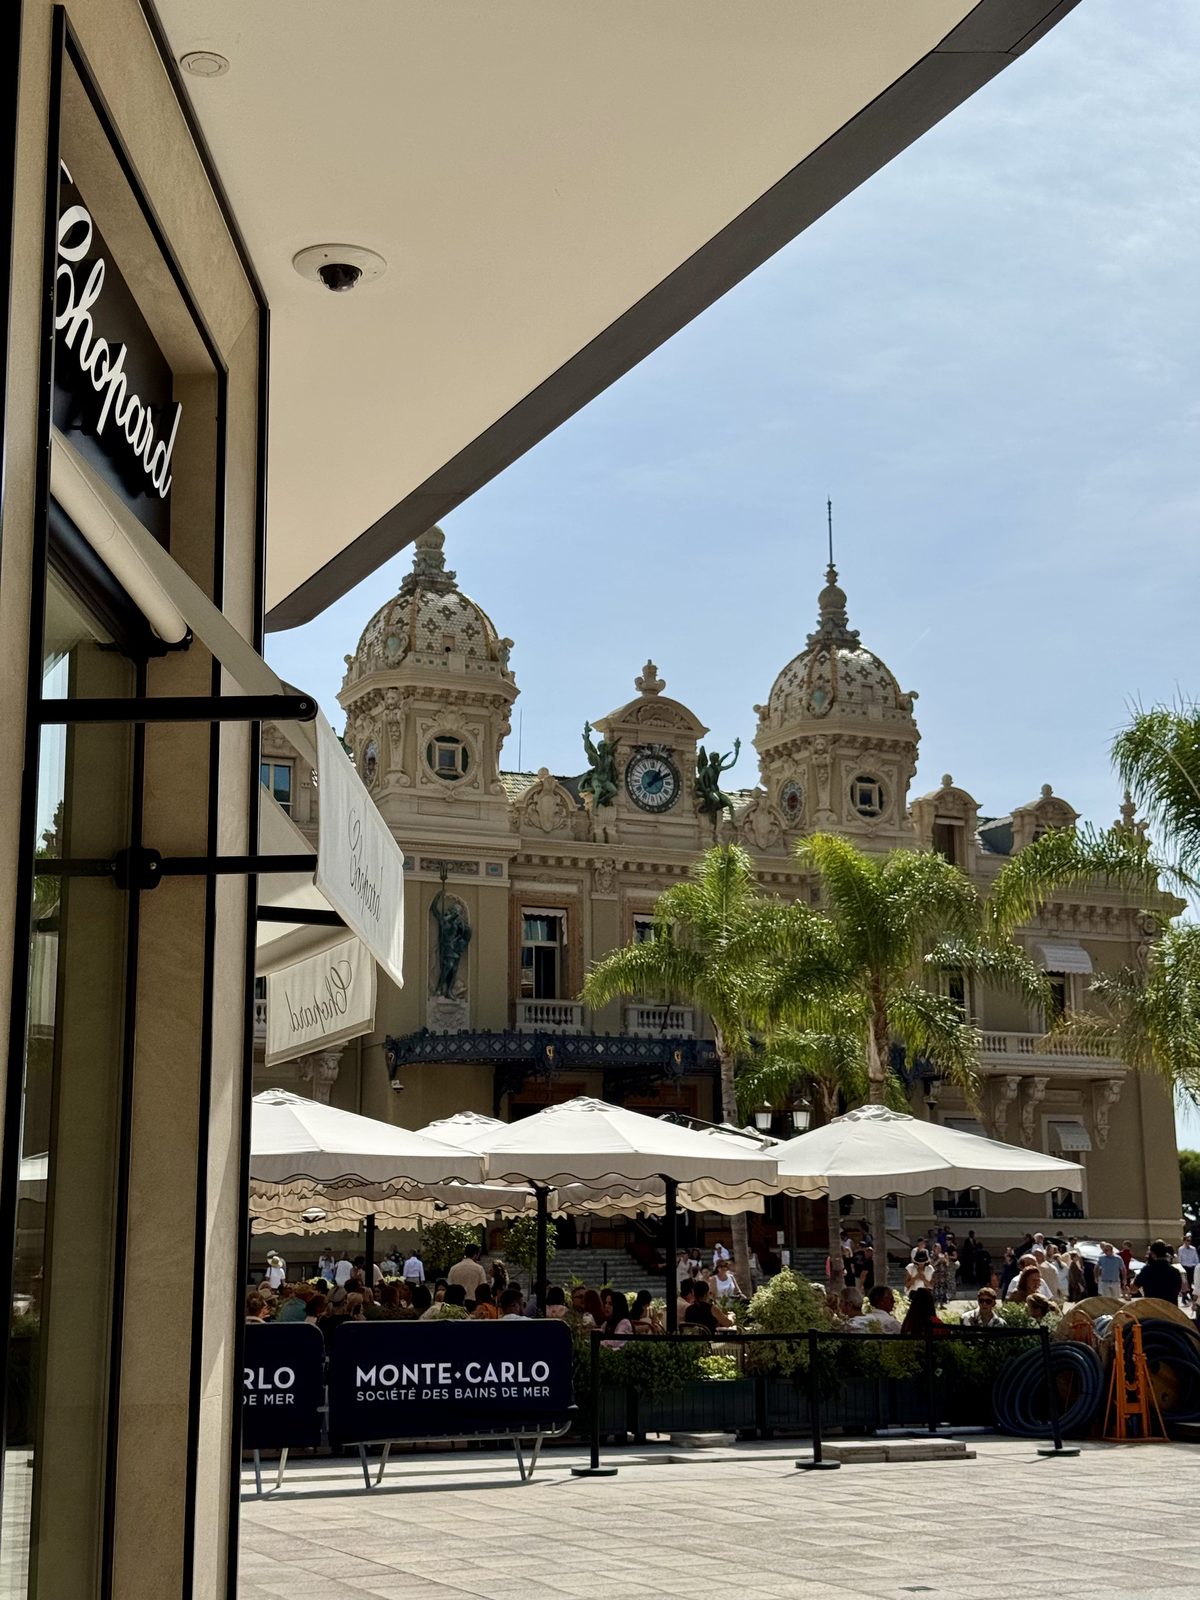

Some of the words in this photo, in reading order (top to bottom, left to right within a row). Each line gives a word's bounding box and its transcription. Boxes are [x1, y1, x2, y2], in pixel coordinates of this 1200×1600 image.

[348, 807, 384, 923] Chopard
[243, 1366, 295, 1390] RLO
[263, 1393, 295, 1405] MER
[356, 1387, 417, 1402] SOCIÉTÉ
[421, 1388, 449, 1400] DES
[454, 1387, 498, 1399] BAINS
[501, 1387, 519, 1398] DE
[522, 1385, 551, 1398] MER
